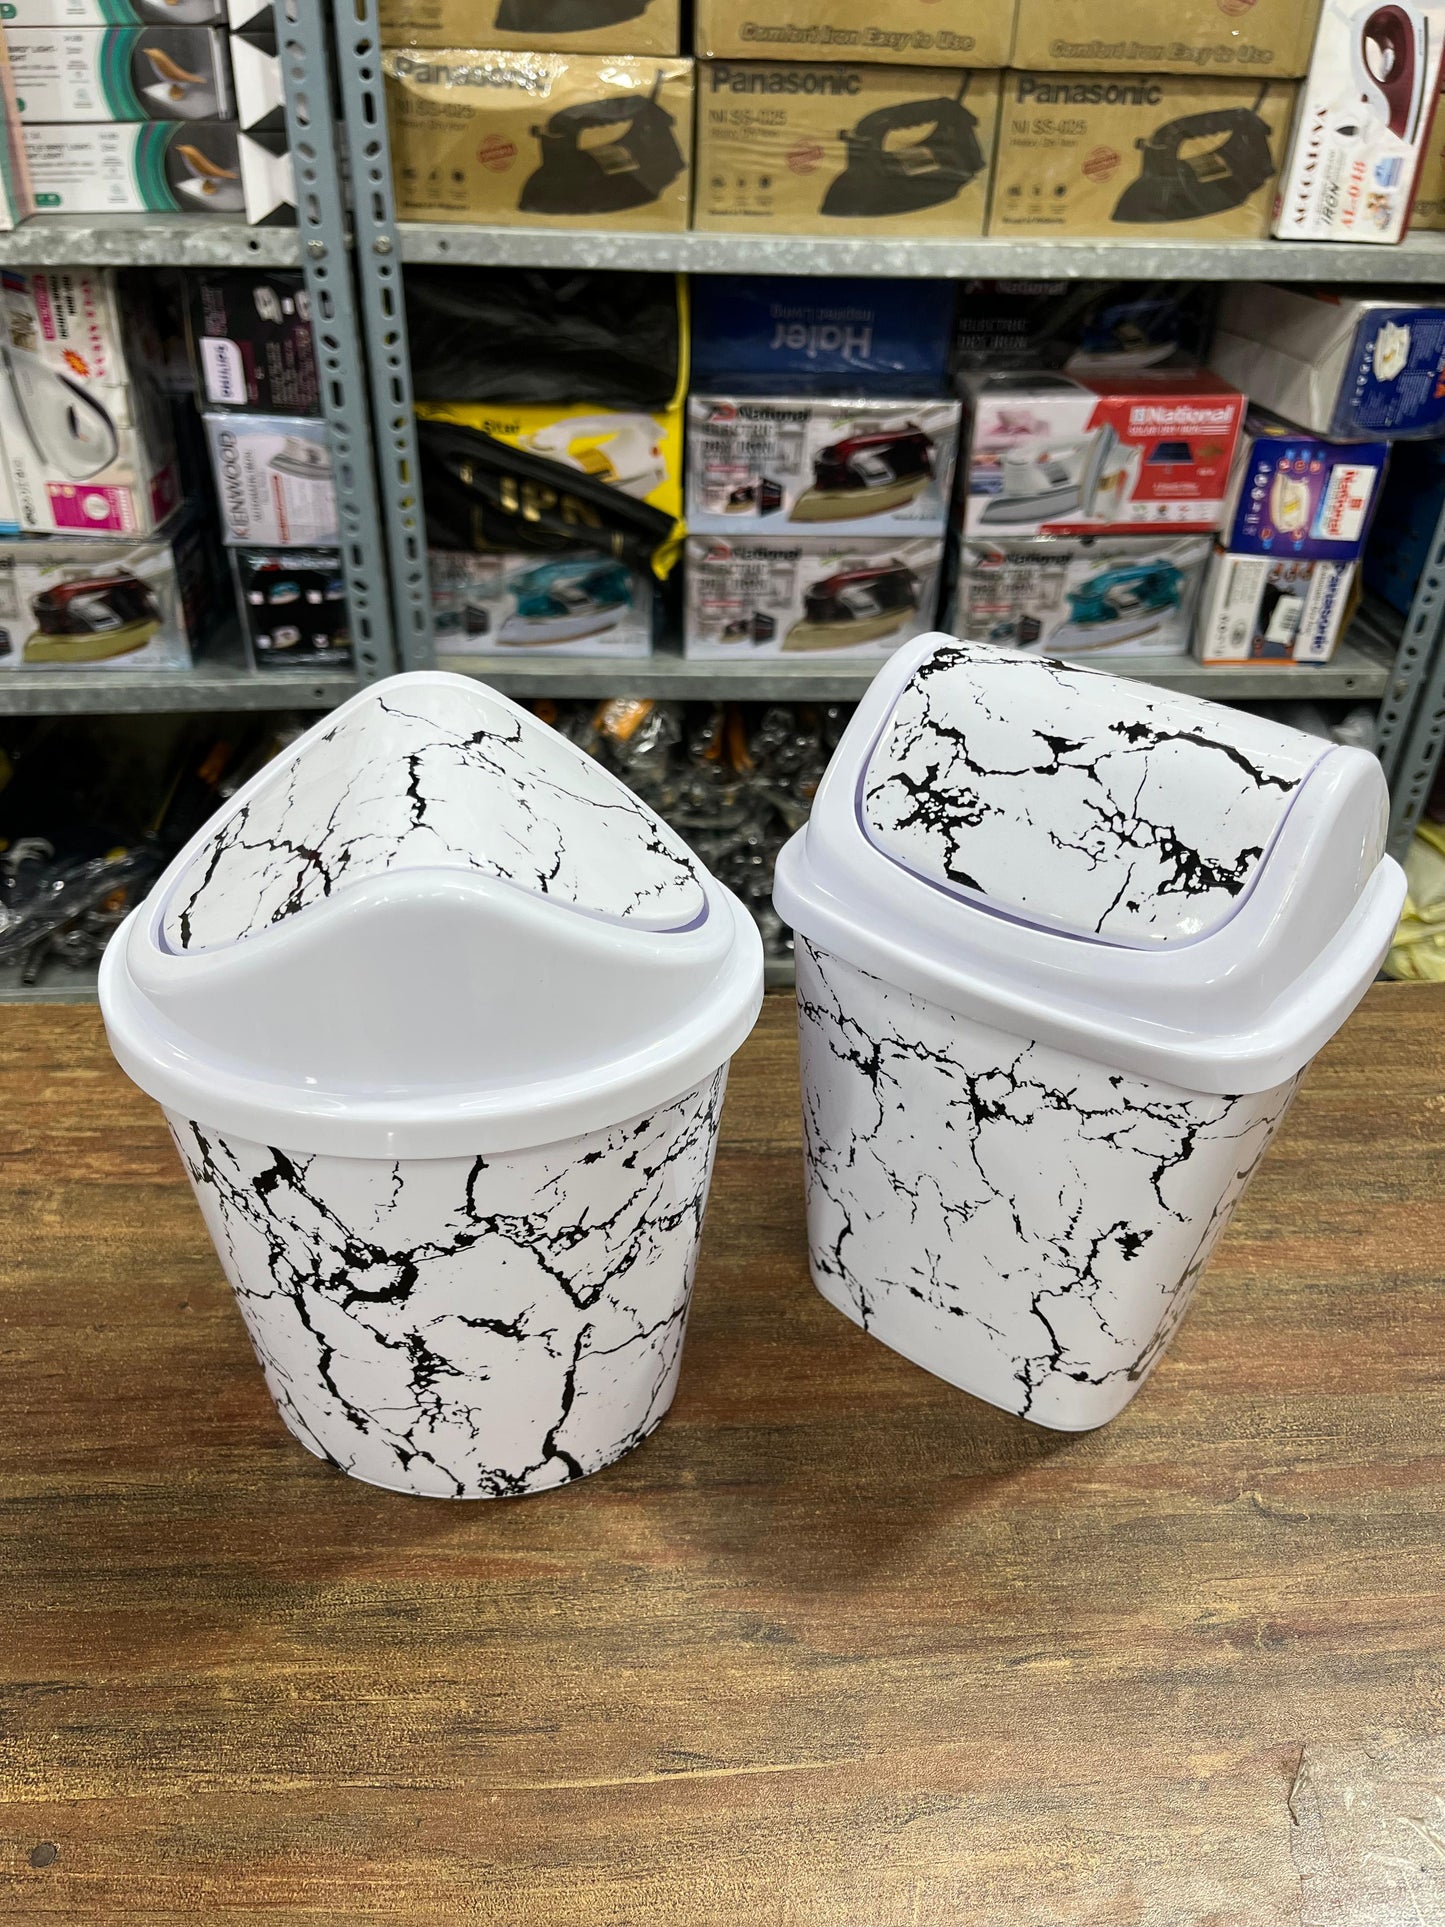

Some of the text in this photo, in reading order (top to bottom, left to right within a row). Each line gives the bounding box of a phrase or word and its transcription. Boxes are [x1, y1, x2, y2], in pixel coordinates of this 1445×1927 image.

[935, 30, 976, 51] Use
[1237, 44, 1274, 64] Use
[711, 64, 862, 95] Panasonic
[1017, 78, 1163, 106] Panasonic
[1320, 182, 1341, 226] IRON
[770, 322, 872, 360] Haier
[214, 345, 234, 398] PHILIPS
[1147, 406, 1235, 425] National
[218, 430, 250, 540] KENWOOD
[1328, 469, 1357, 537] National
[1310, 562, 1347, 655] Panasonic
